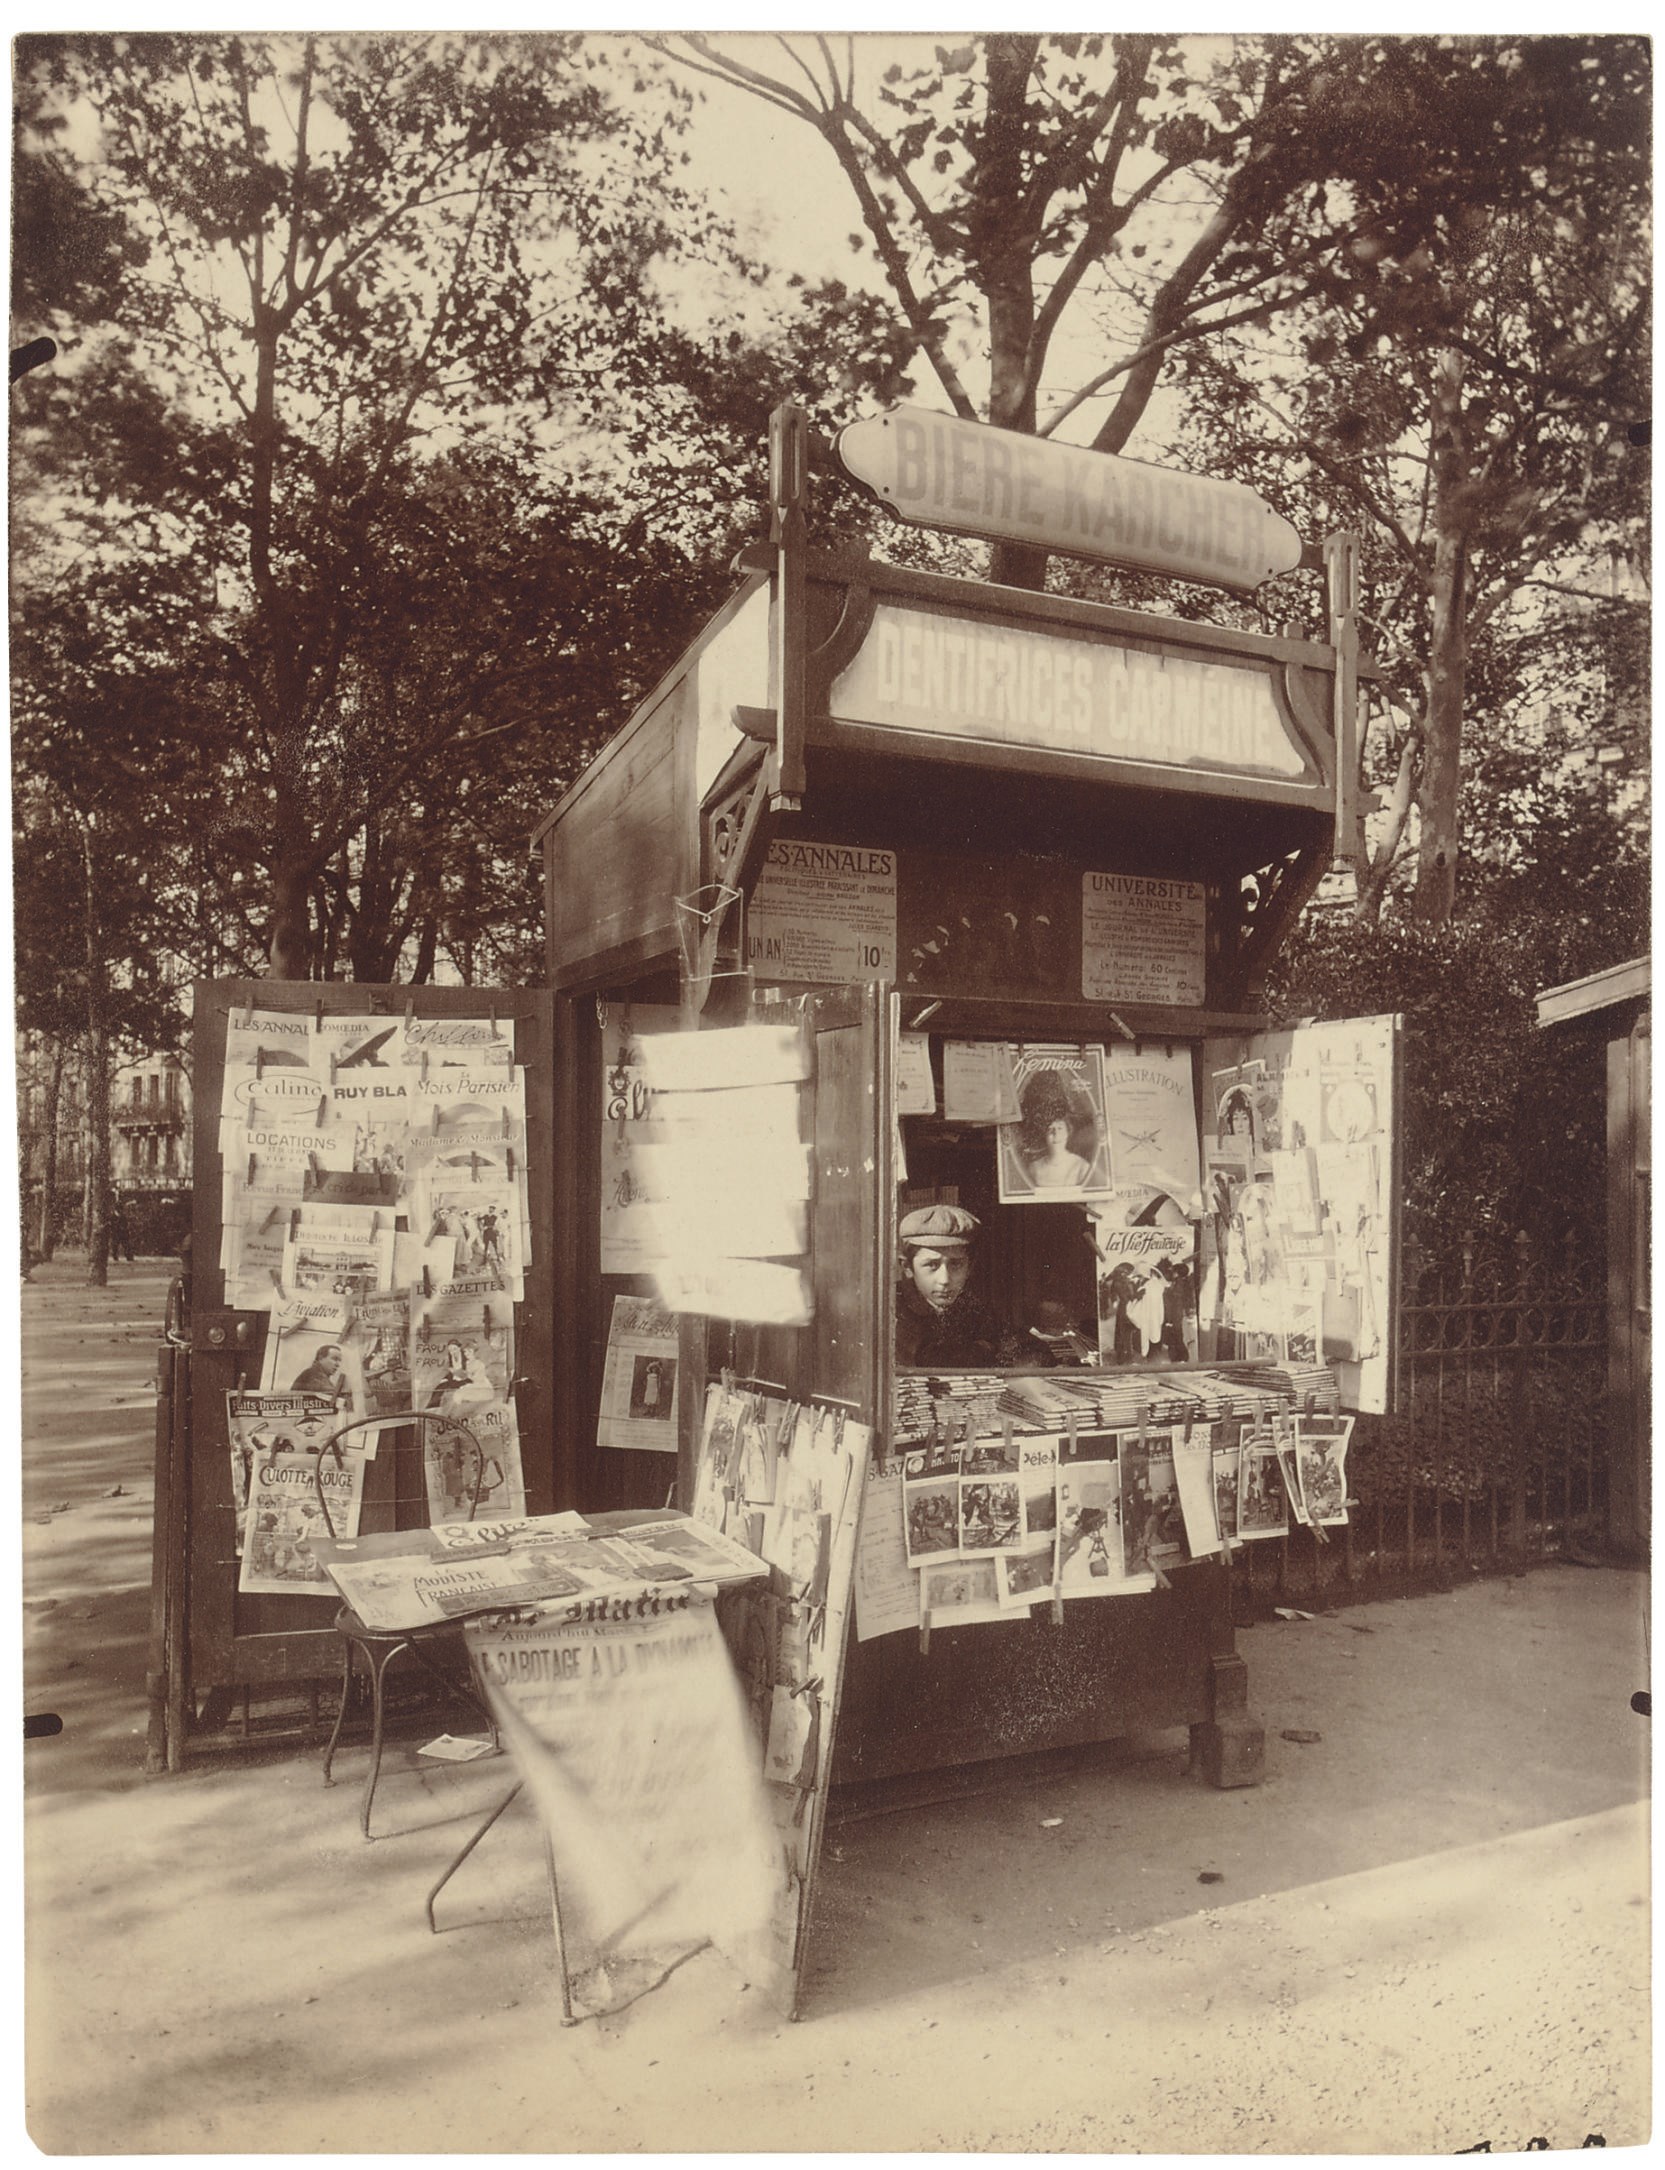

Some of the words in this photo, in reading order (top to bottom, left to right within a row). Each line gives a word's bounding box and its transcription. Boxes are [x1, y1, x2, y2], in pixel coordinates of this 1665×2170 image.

[1061, 454, 1266, 578] KARCHER
[877, 620, 1093, 734] DENTIFRICES
[792, 845, 892, 875] ANNALES
[1128, 897, 1183, 912] ANNALES
[748, 937, 763, 959] UN
[766, 938, 781, 960] AN
[864, 945, 880, 968] 10
[333, 1086, 368, 1100] RUY
[456, 1079, 520, 1095] Parisien
[247, 1132, 337, 1151] LOCATIONS
[416, 1284, 438, 1296] LS
[440, 1280, 506, 1295] GAZETTES
[259, 1399, 292, 1410] Divers
[259, 1465, 306, 1486] CULOTTE
[414, 1571, 489, 1589] MODISTE
[561, 1587, 690, 1626] Matin
[499, 1647, 582, 1686] SABOTAGE
